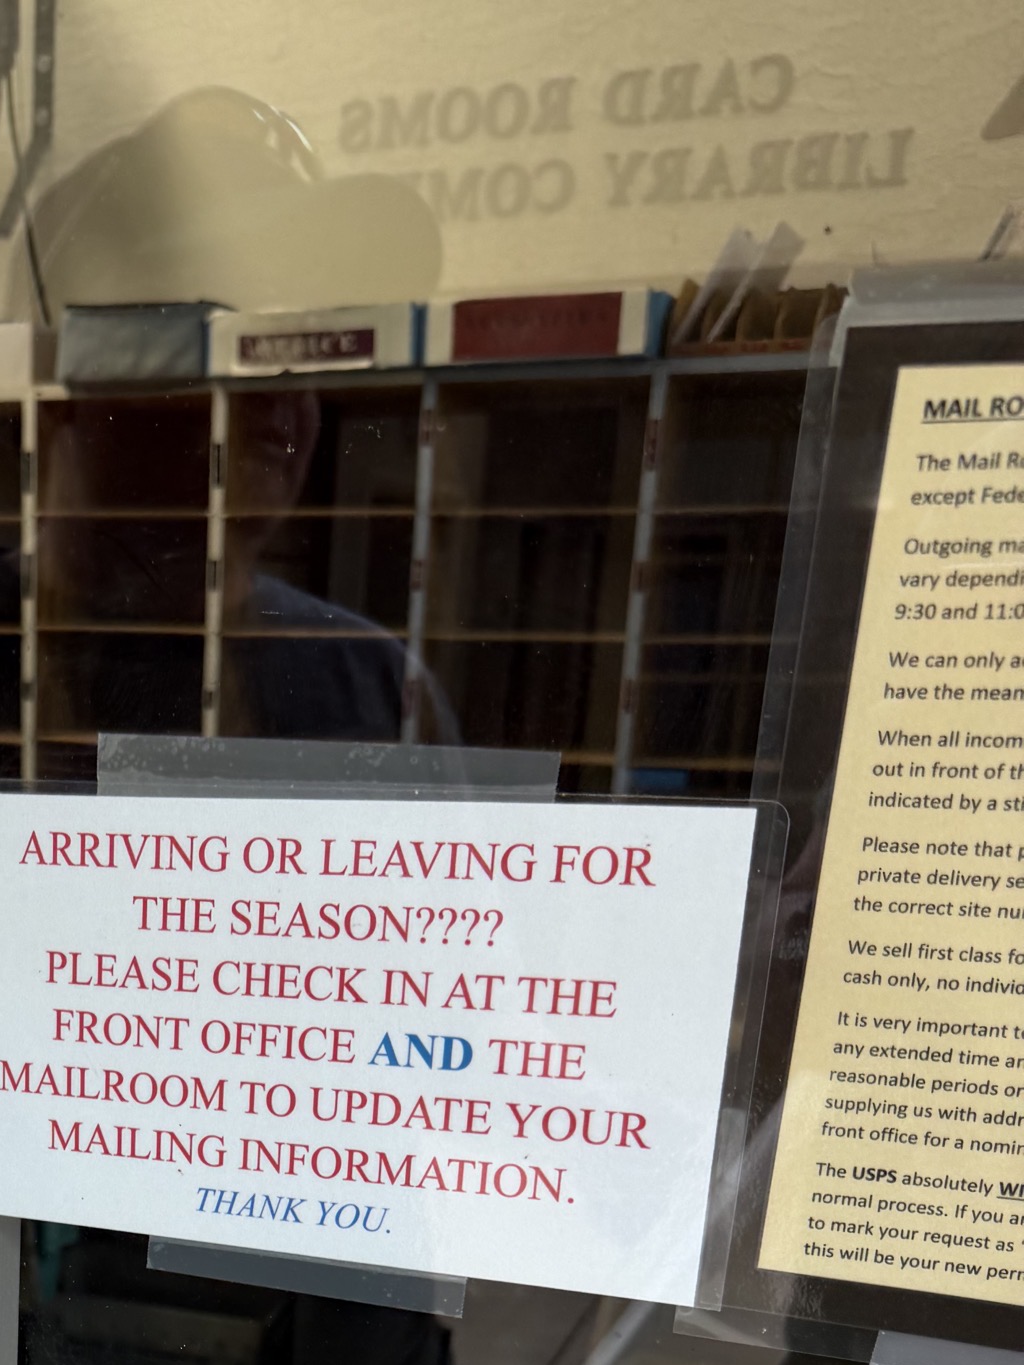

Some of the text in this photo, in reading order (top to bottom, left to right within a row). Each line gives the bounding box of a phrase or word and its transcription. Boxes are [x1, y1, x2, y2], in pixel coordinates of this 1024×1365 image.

[923, 398, 982, 418] MAIL
[917, 452, 1001, 471] The Mail
[911, 489, 975, 508] except
[904, 538, 993, 558] Outgoing
[900, 575, 940, 591] vary
[895, 604, 937, 620] 9:30
[942, 603, 978, 619] and
[889, 652, 1005, 672] We can only
[884, 683, 928, 700] have
[934, 684, 965, 700] the
[878, 730, 931, 746] When
[938, 731, 959, 747] all
[873, 763, 903, 777] out
[910, 762, 925, 777] in
[932, 762, 978, 779] front
[984, 763, 1005, 779] of
[869, 792, 953, 809] indicated
[960, 794, 981, 814] by
[987, 799, 997, 810] a
[863, 836, 1012, 857] Please note that
[20, 830, 655, 887] ARRIVING OR LEAVING FOR
[858, 868, 921, 885] private
[927, 869, 1001, 891] delivery
[854, 896, 882, 912] the
[889, 902, 953, 916] correct
[959, 902, 991, 917] site
[133, 894, 504, 948] THE SEASON????
[849, 940, 877, 955] We
[883, 943, 912, 958] sell
[918, 944, 953, 960] first
[959, 947, 1001, 963] class
[45, 950, 617, 1019] PLEASE CHECK IN AT THE
[844, 970, 881, 985] cash
[888, 972, 929, 991] only,
[937, 979, 959, 990] no
[838, 1012, 1008, 1038] It is very important
[52, 1007, 586, 1081] FRONT OFFICE AND THE
[834, 1043, 864, 1058] any
[870, 1045, 953, 1063] extended
[959, 1050, 999, 1067] time
[830, 1071, 925, 1089] reasonable
[931, 1080, 998, 1095] periods
[0, 1060, 650, 1150] MAILROOM TO UPDATE YOUR
[825, 1098, 908, 1119] supplying
[914, 1106, 932, 1118] us
[939, 1107, 976, 1122] with
[822, 1121, 865, 1139] front
[870, 1127, 918, 1144] office
[924, 1131, 950, 1147] for
[954, 1139, 964, 1149] a
[48, 1119, 575, 1206] MAILING INFORMATION.
[816, 1163, 846, 1178] The
[853, 1166, 897, 1183] USPS
[902, 1172, 993, 1197] absolutely
[196, 1187, 392, 1235] THANK YOU.
[812, 1193, 1003, 1223] normal process. If you
[808, 1217, 1014, 1252] to mark your request as
[804, 1242, 834, 1258] this
[840, 1248, 869, 1262] will
[874, 1249, 894, 1265] be
[900, 1256, 940, 1270] your
[945, 1262, 981, 1275] new
